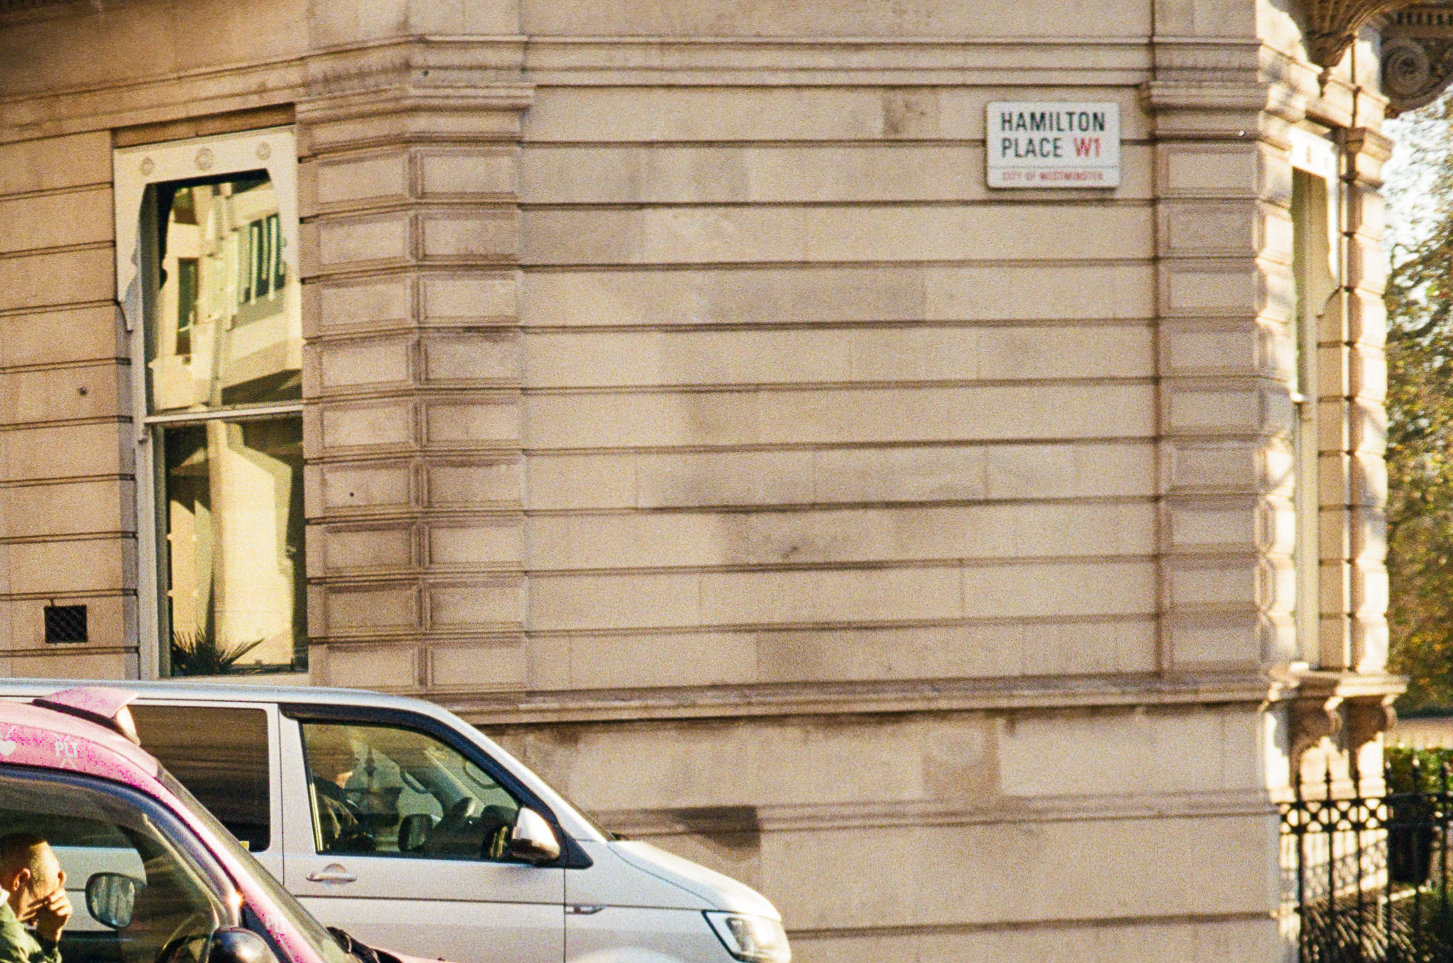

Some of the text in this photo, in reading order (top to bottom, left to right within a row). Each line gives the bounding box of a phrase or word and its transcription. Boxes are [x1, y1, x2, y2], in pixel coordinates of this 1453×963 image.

[1001, 111, 1105, 132] HAMILTON
[1001, 137, 1101, 158] PLACE W1
